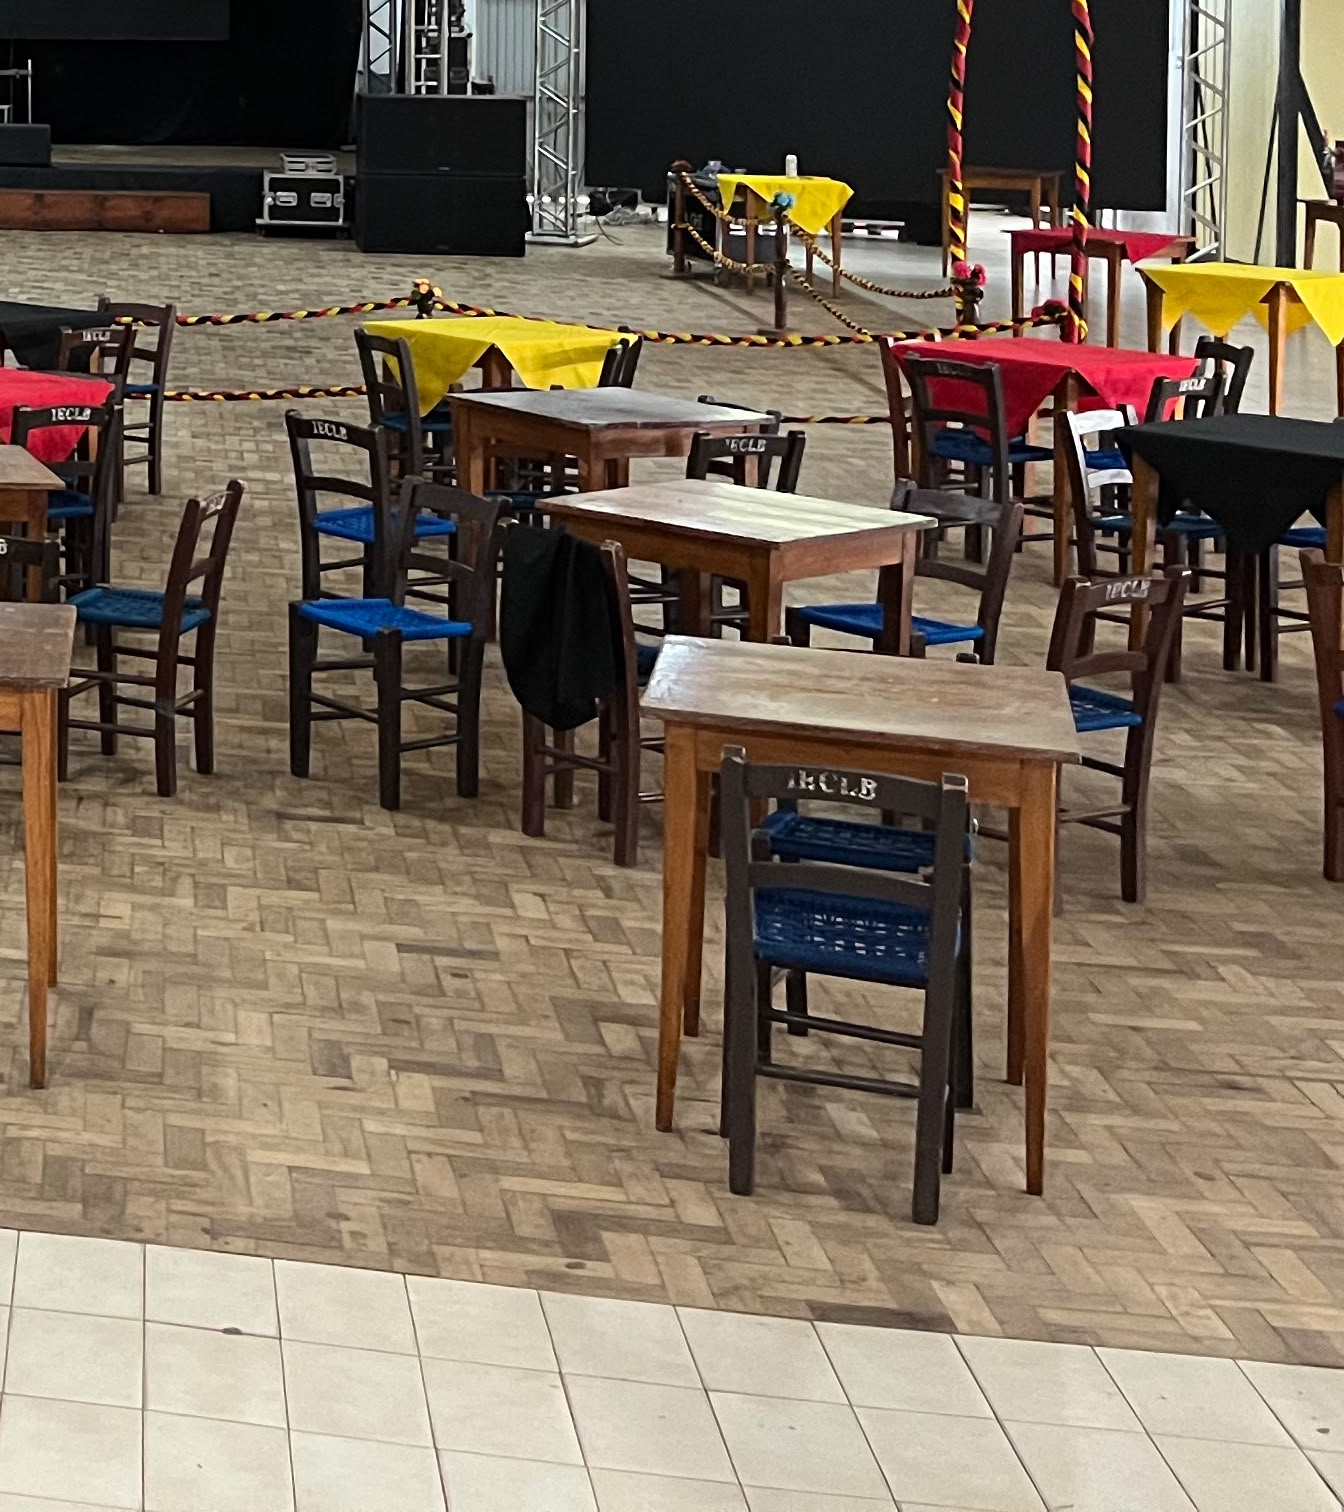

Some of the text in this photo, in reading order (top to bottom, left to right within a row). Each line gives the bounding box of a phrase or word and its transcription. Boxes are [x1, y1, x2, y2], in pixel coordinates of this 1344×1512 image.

[51, 407, 91, 422] IECLB
[311, 420, 348, 440] IECLB
[787, 769, 878, 800] IECLB
